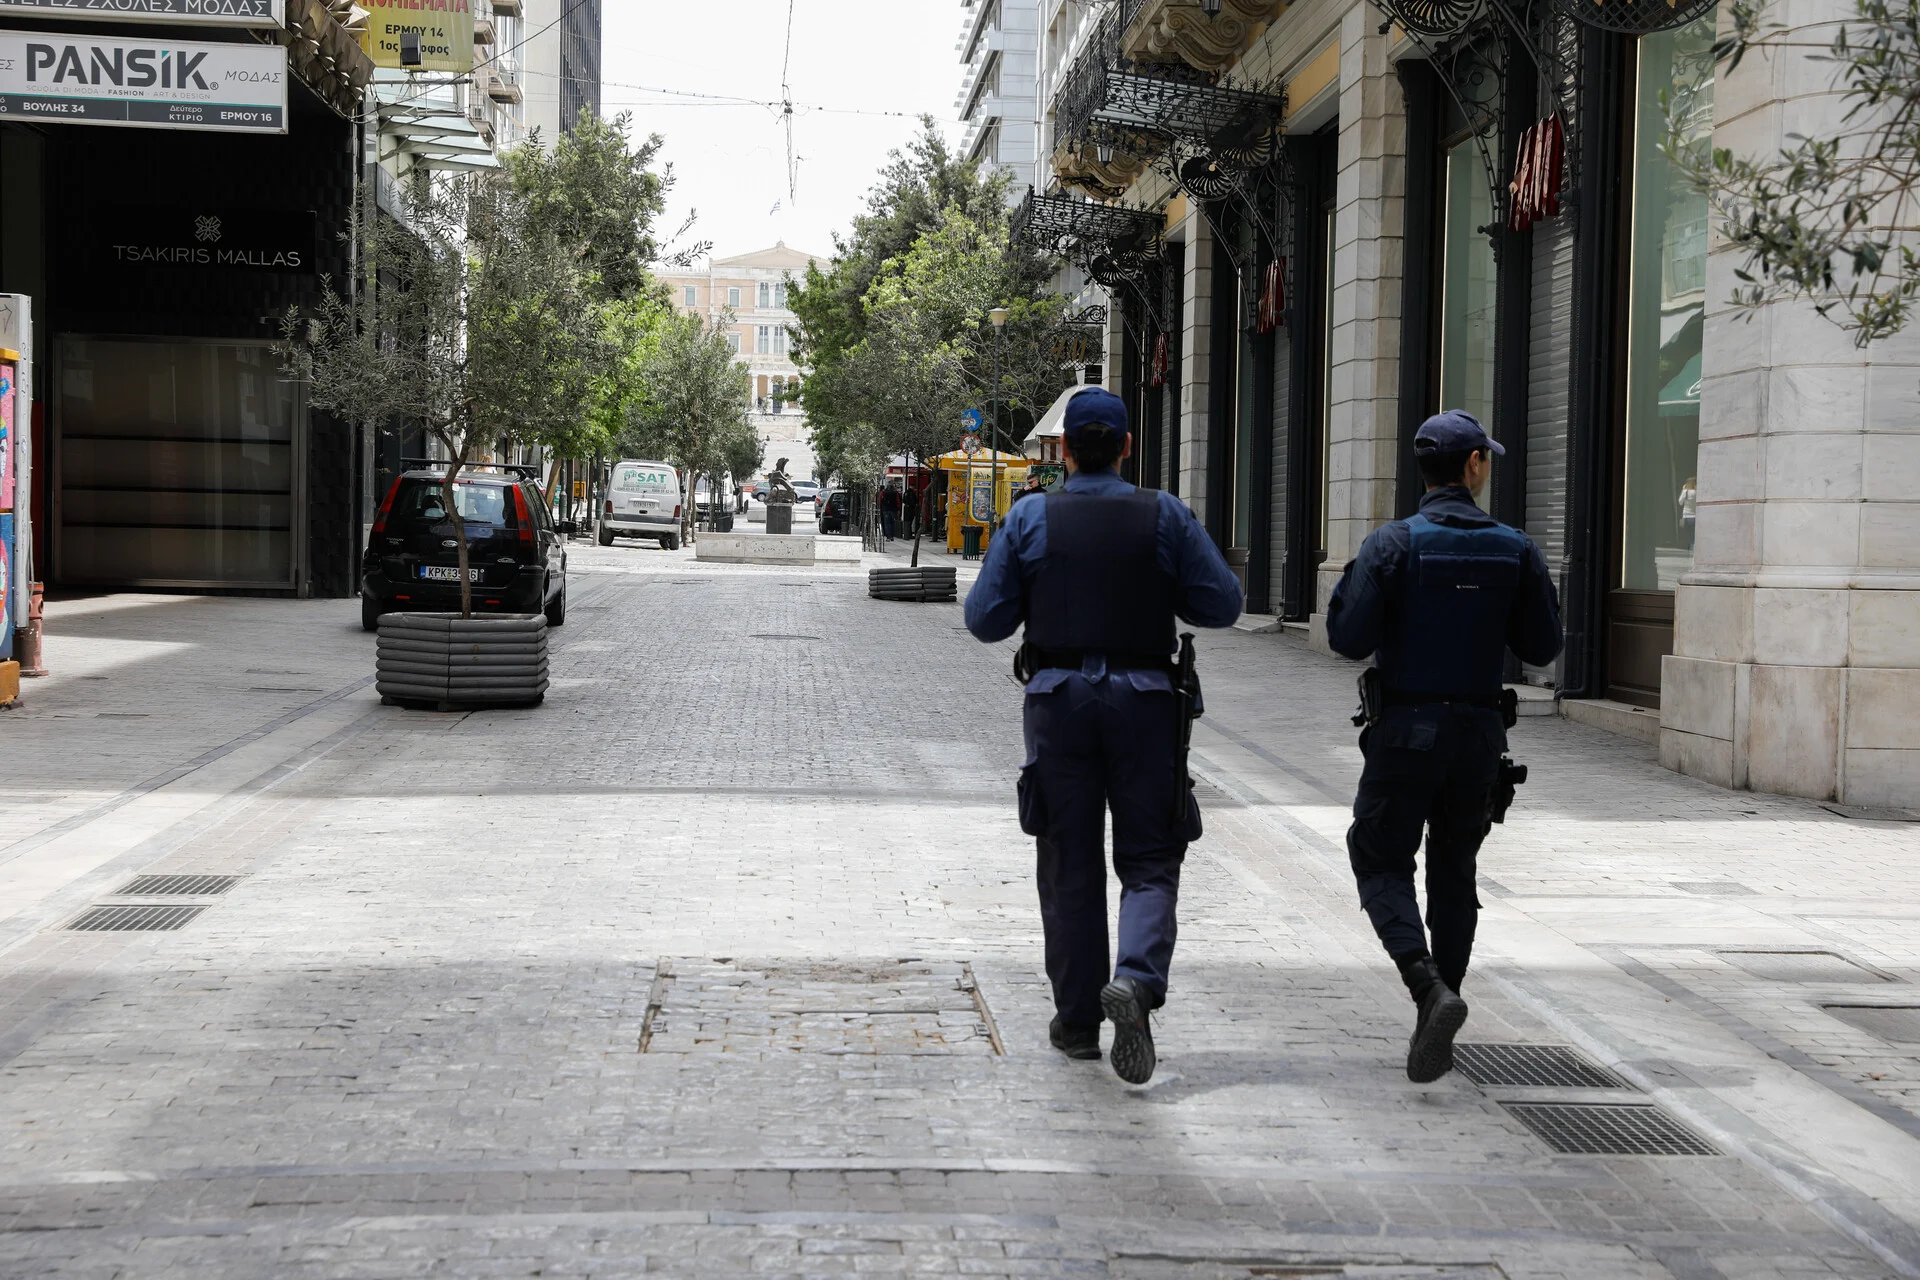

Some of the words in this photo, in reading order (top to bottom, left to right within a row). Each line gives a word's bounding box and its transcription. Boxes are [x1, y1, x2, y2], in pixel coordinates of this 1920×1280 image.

[185, 0, 268, 17] ΜΟΔΑΣ
[385, 24, 427, 37] ΕΡΜΟΥ
[430, 27, 444, 38] 14
[379, 40, 399, 52] 1ος
[421, 45, 449, 56] οφος
[224, 70, 282, 84] ΜΟΔΑΣ
[26, 84, 60, 93] SCUOLA
[74, 87, 99, 95] MODA
[107, 88, 145, 97] FASHION
[180, 92, 211, 100] DESIGN
[23, 101, 69, 113] ΒΟΥΛΗΣ
[71, 104, 86, 114] 34
[169, 104, 203, 114] Δεύτερο
[169, 113, 203, 122] ΚΤΙΡΙΟ
[220, 111, 259, 122] ΕΡΜΟΥ
[261, 112, 273, 122] 16
[112, 244, 211, 265] TSAKIRIS
[216, 248, 301, 268] MALLAS
[637, 472, 667, 484] SAT
